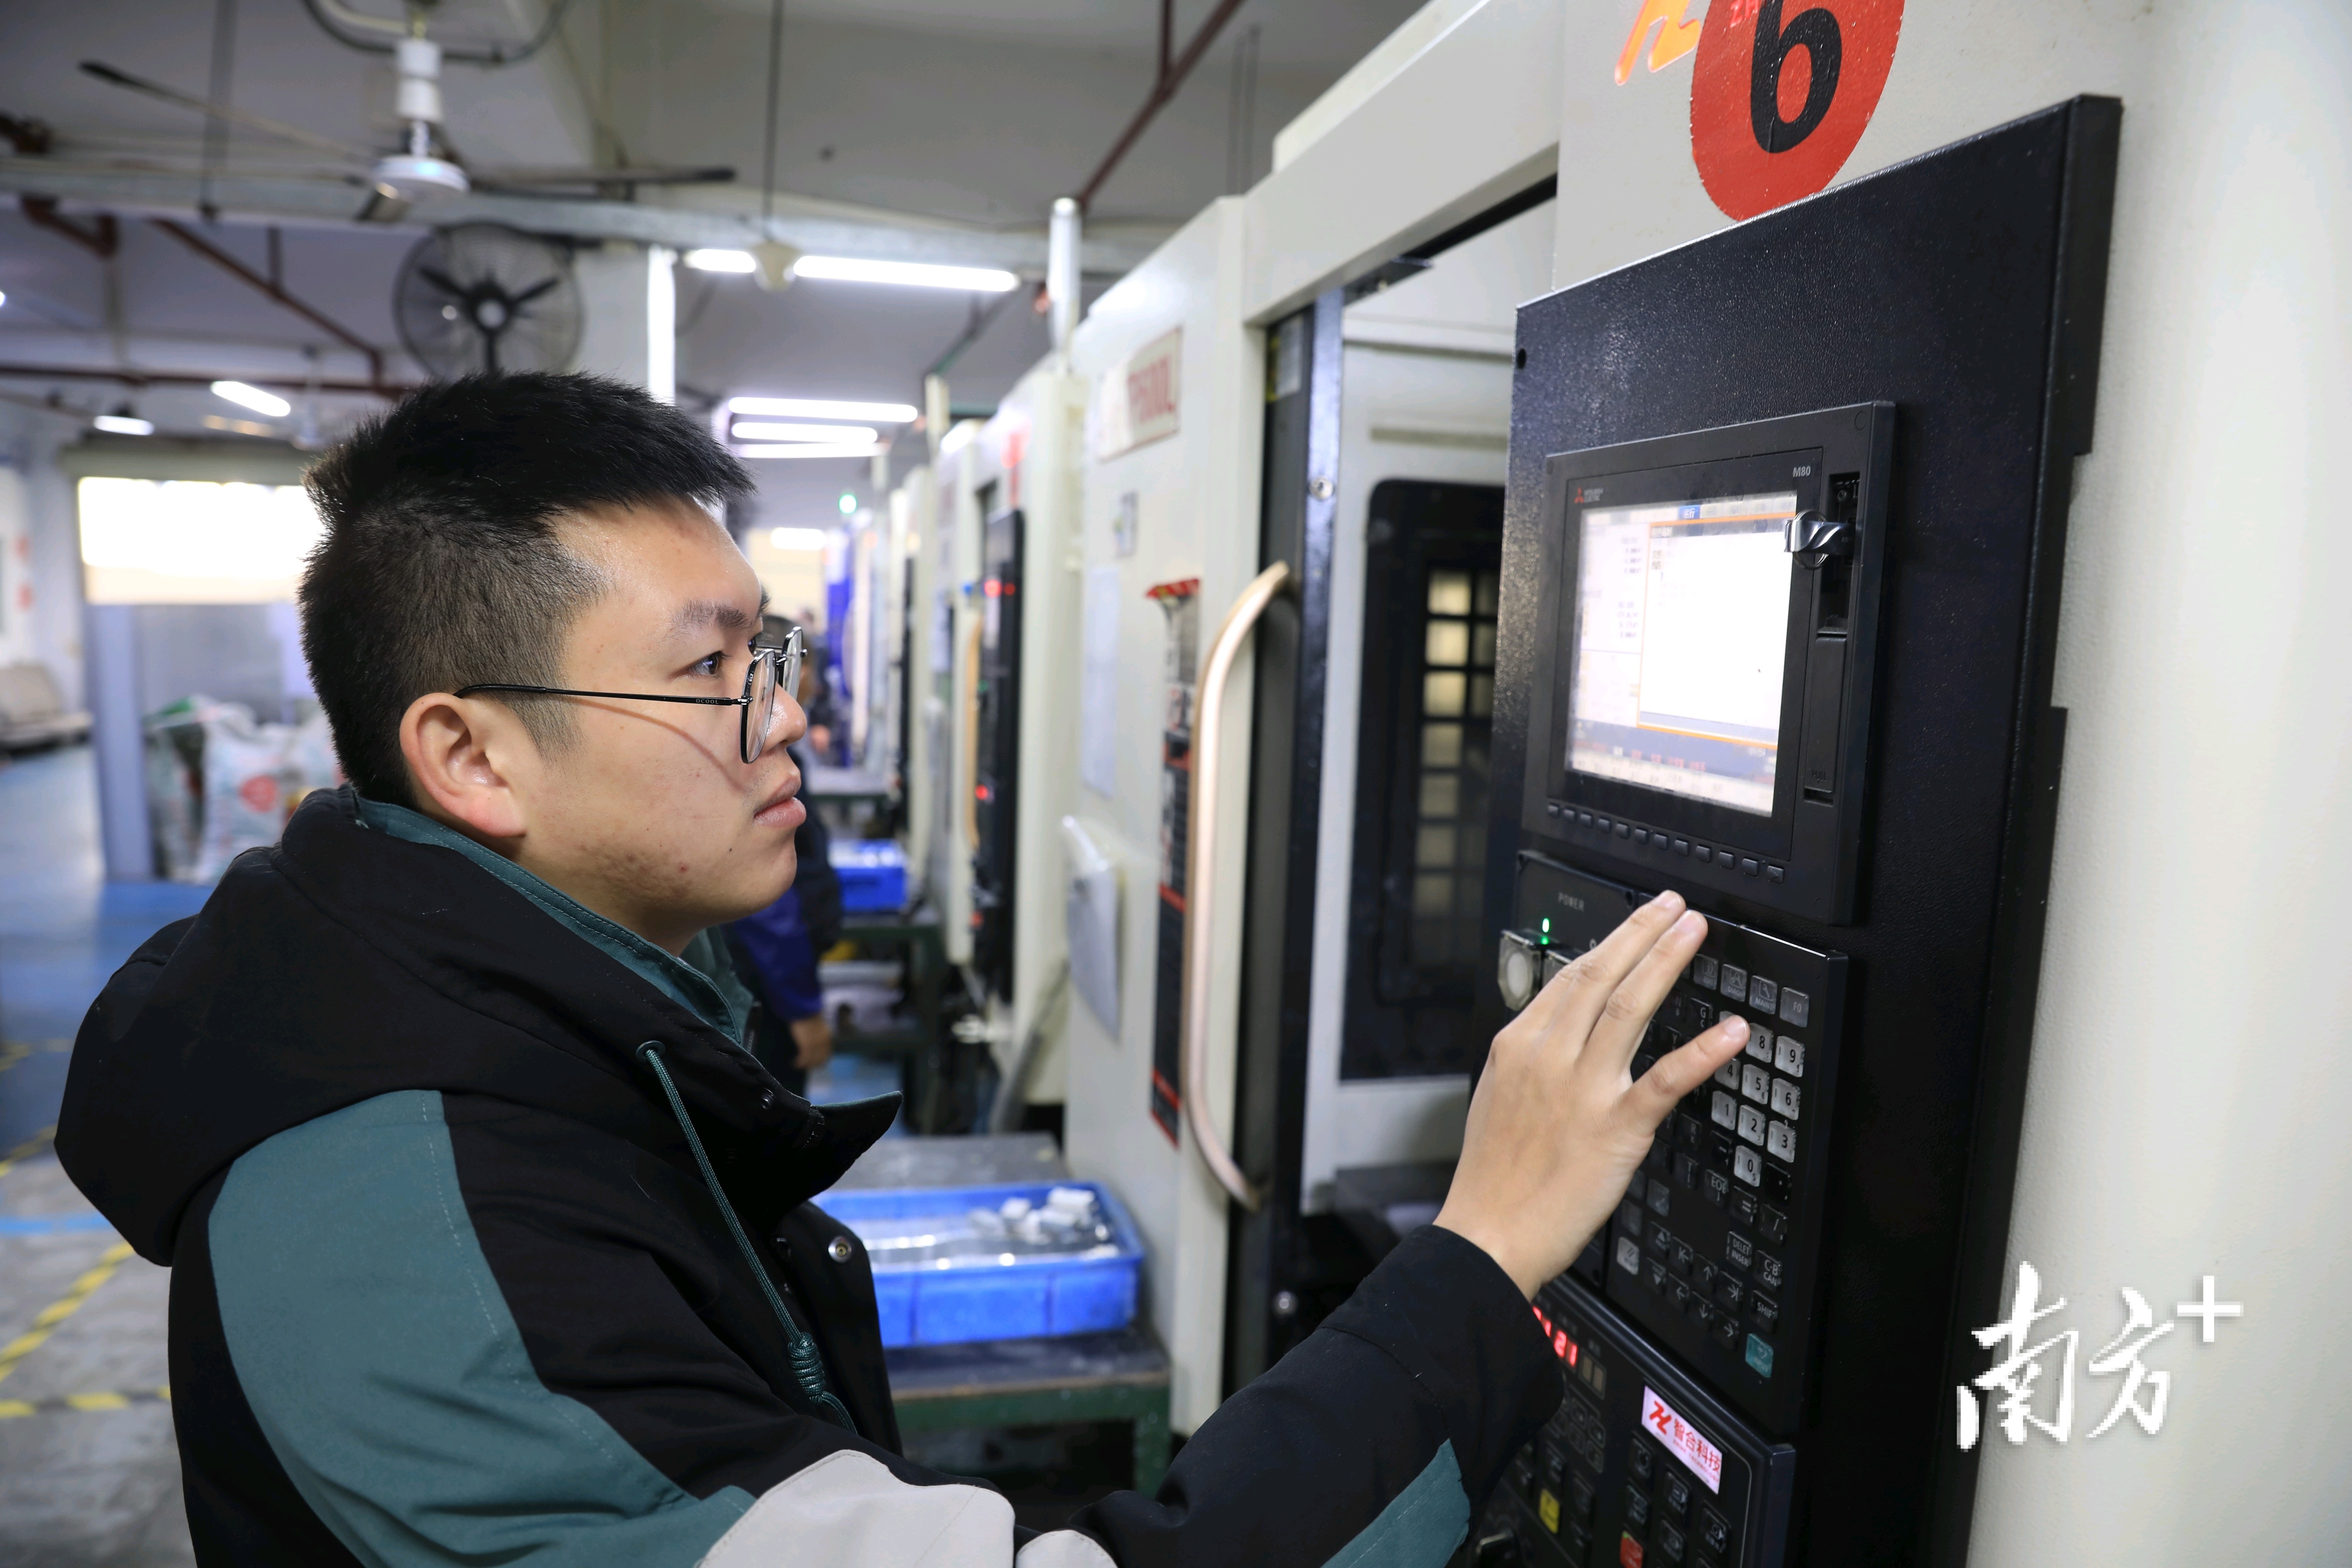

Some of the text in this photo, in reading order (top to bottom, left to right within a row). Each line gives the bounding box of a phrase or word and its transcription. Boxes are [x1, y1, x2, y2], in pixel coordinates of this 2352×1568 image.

[1750, 0, 1842, 153] 6
[1793, 466, 1811, 478] M80
[1811, 769, 1827, 781] PULL
[1558, 892, 1584, 911] POWER
[1700, 1007, 1706, 1018] G
[1759, 1035, 1766, 1049] 8
[1789, 1049, 1796, 1063] 9
[1727, 1064, 1733, 1077] 4
[1756, 1077, 1761, 1091] 5
[1785, 1092, 1791, 1105] 6
[1725, 1104, 1729, 1116] 1
[1751, 1118, 1757, 1132] 2
[1782, 1134, 1788, 1149] 3
[1674, 1419, 1721, 1473] 智合科技
